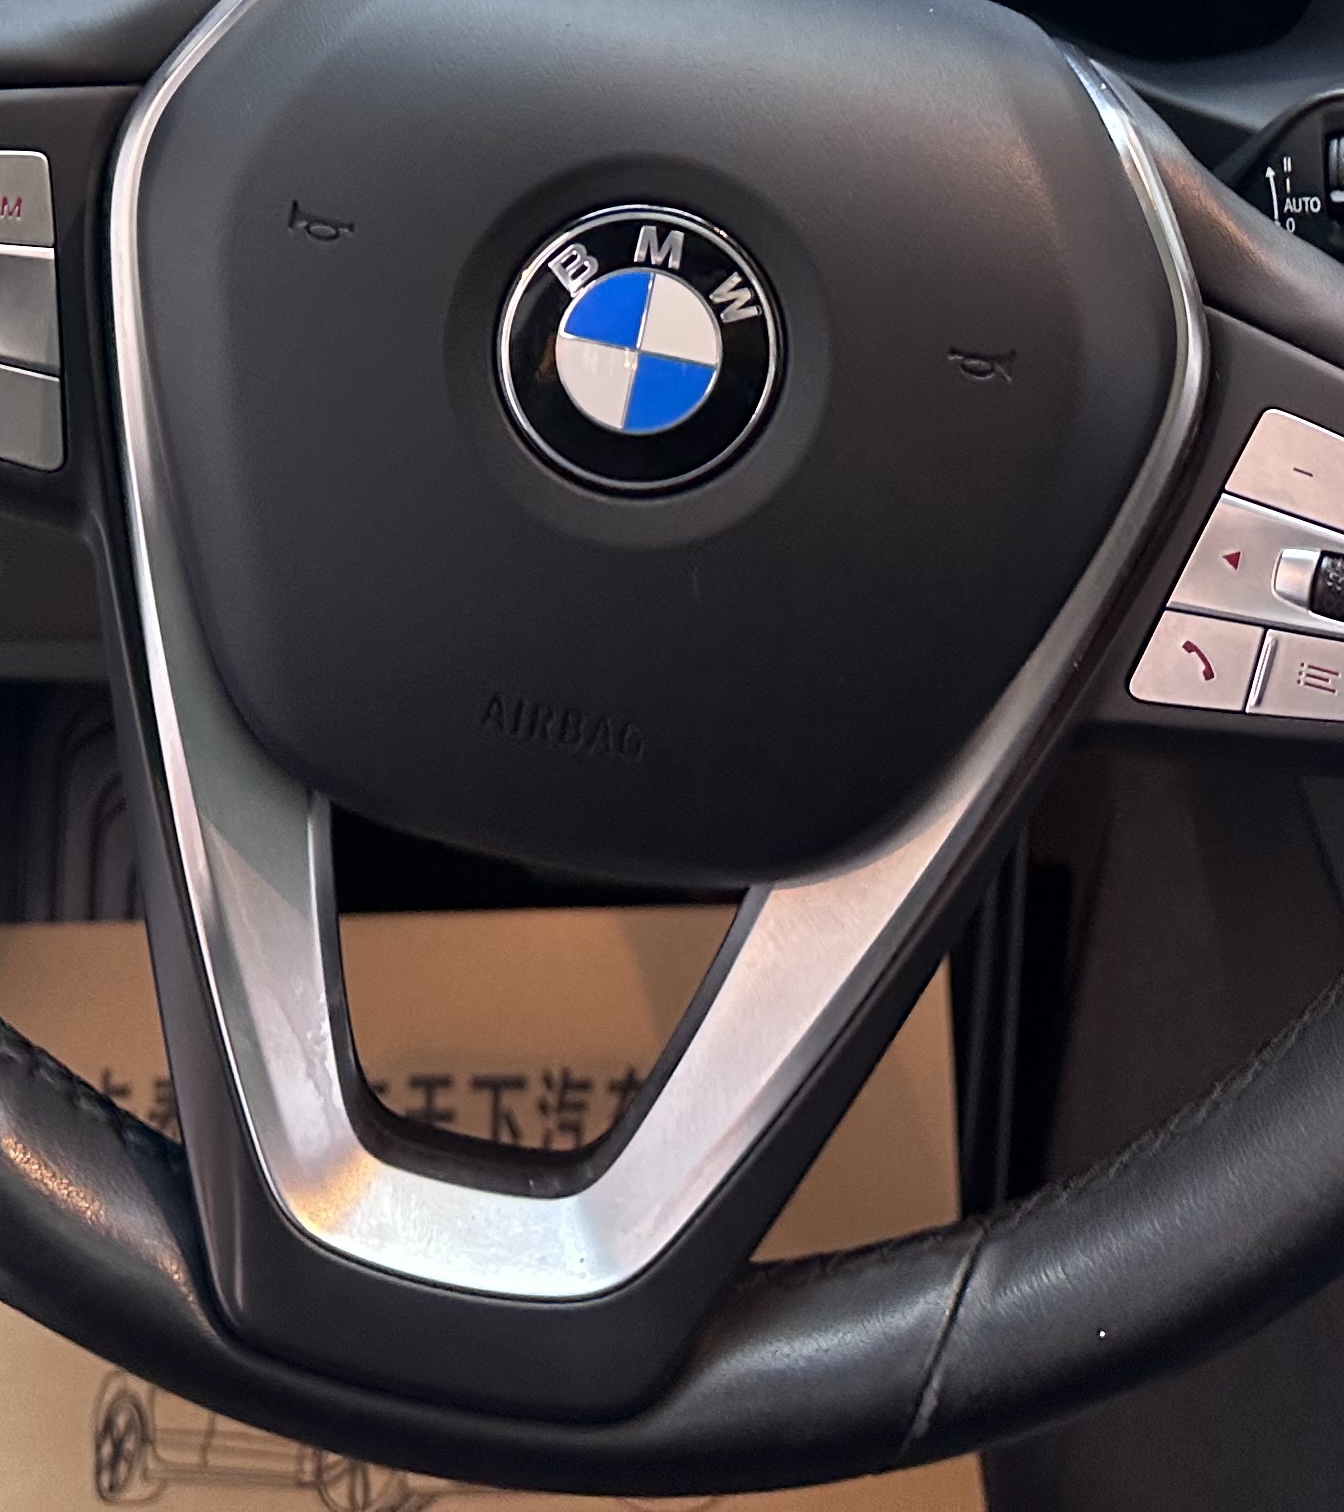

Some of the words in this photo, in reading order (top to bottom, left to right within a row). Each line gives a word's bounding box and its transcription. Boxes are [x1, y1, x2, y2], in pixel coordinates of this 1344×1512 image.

[1284, 196, 1321, 214] AUTO
[547, 225, 763, 325] BMW
[480, 692, 646, 763] AIRBAG
